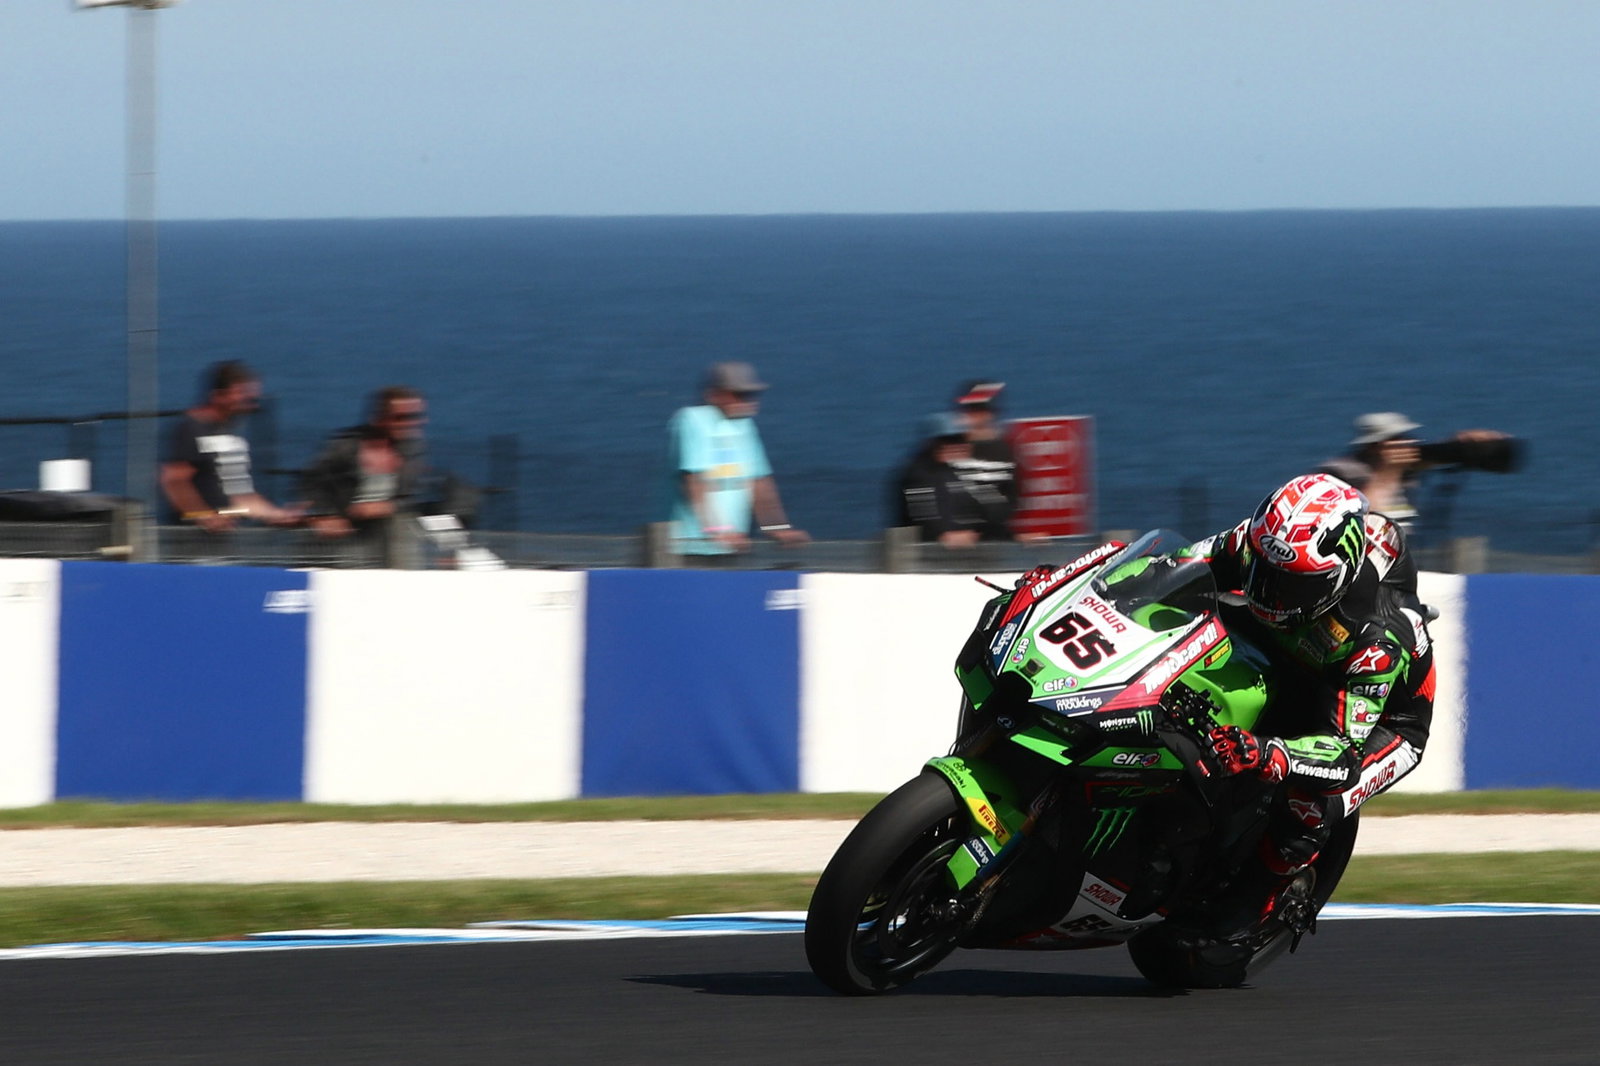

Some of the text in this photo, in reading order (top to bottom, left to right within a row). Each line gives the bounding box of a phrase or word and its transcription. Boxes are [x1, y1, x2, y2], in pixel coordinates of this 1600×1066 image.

[1262, 538, 1293, 559] Arai
[1079, 596, 1127, 633] SHOWA
[1017, 638, 1029, 654] elf
[1039, 612, 1118, 671] 65
[1042, 678, 1066, 692] elf
[1100, 717, 1137, 728] MONSTER
[1112, 753, 1144, 766] elf
[1291, 759, 1349, 781] Kawasaki
[1347, 761, 1396, 812] SHOWA
[978, 804, 1006, 839] PIRELLI
[1085, 883, 1122, 906] SHOWA
